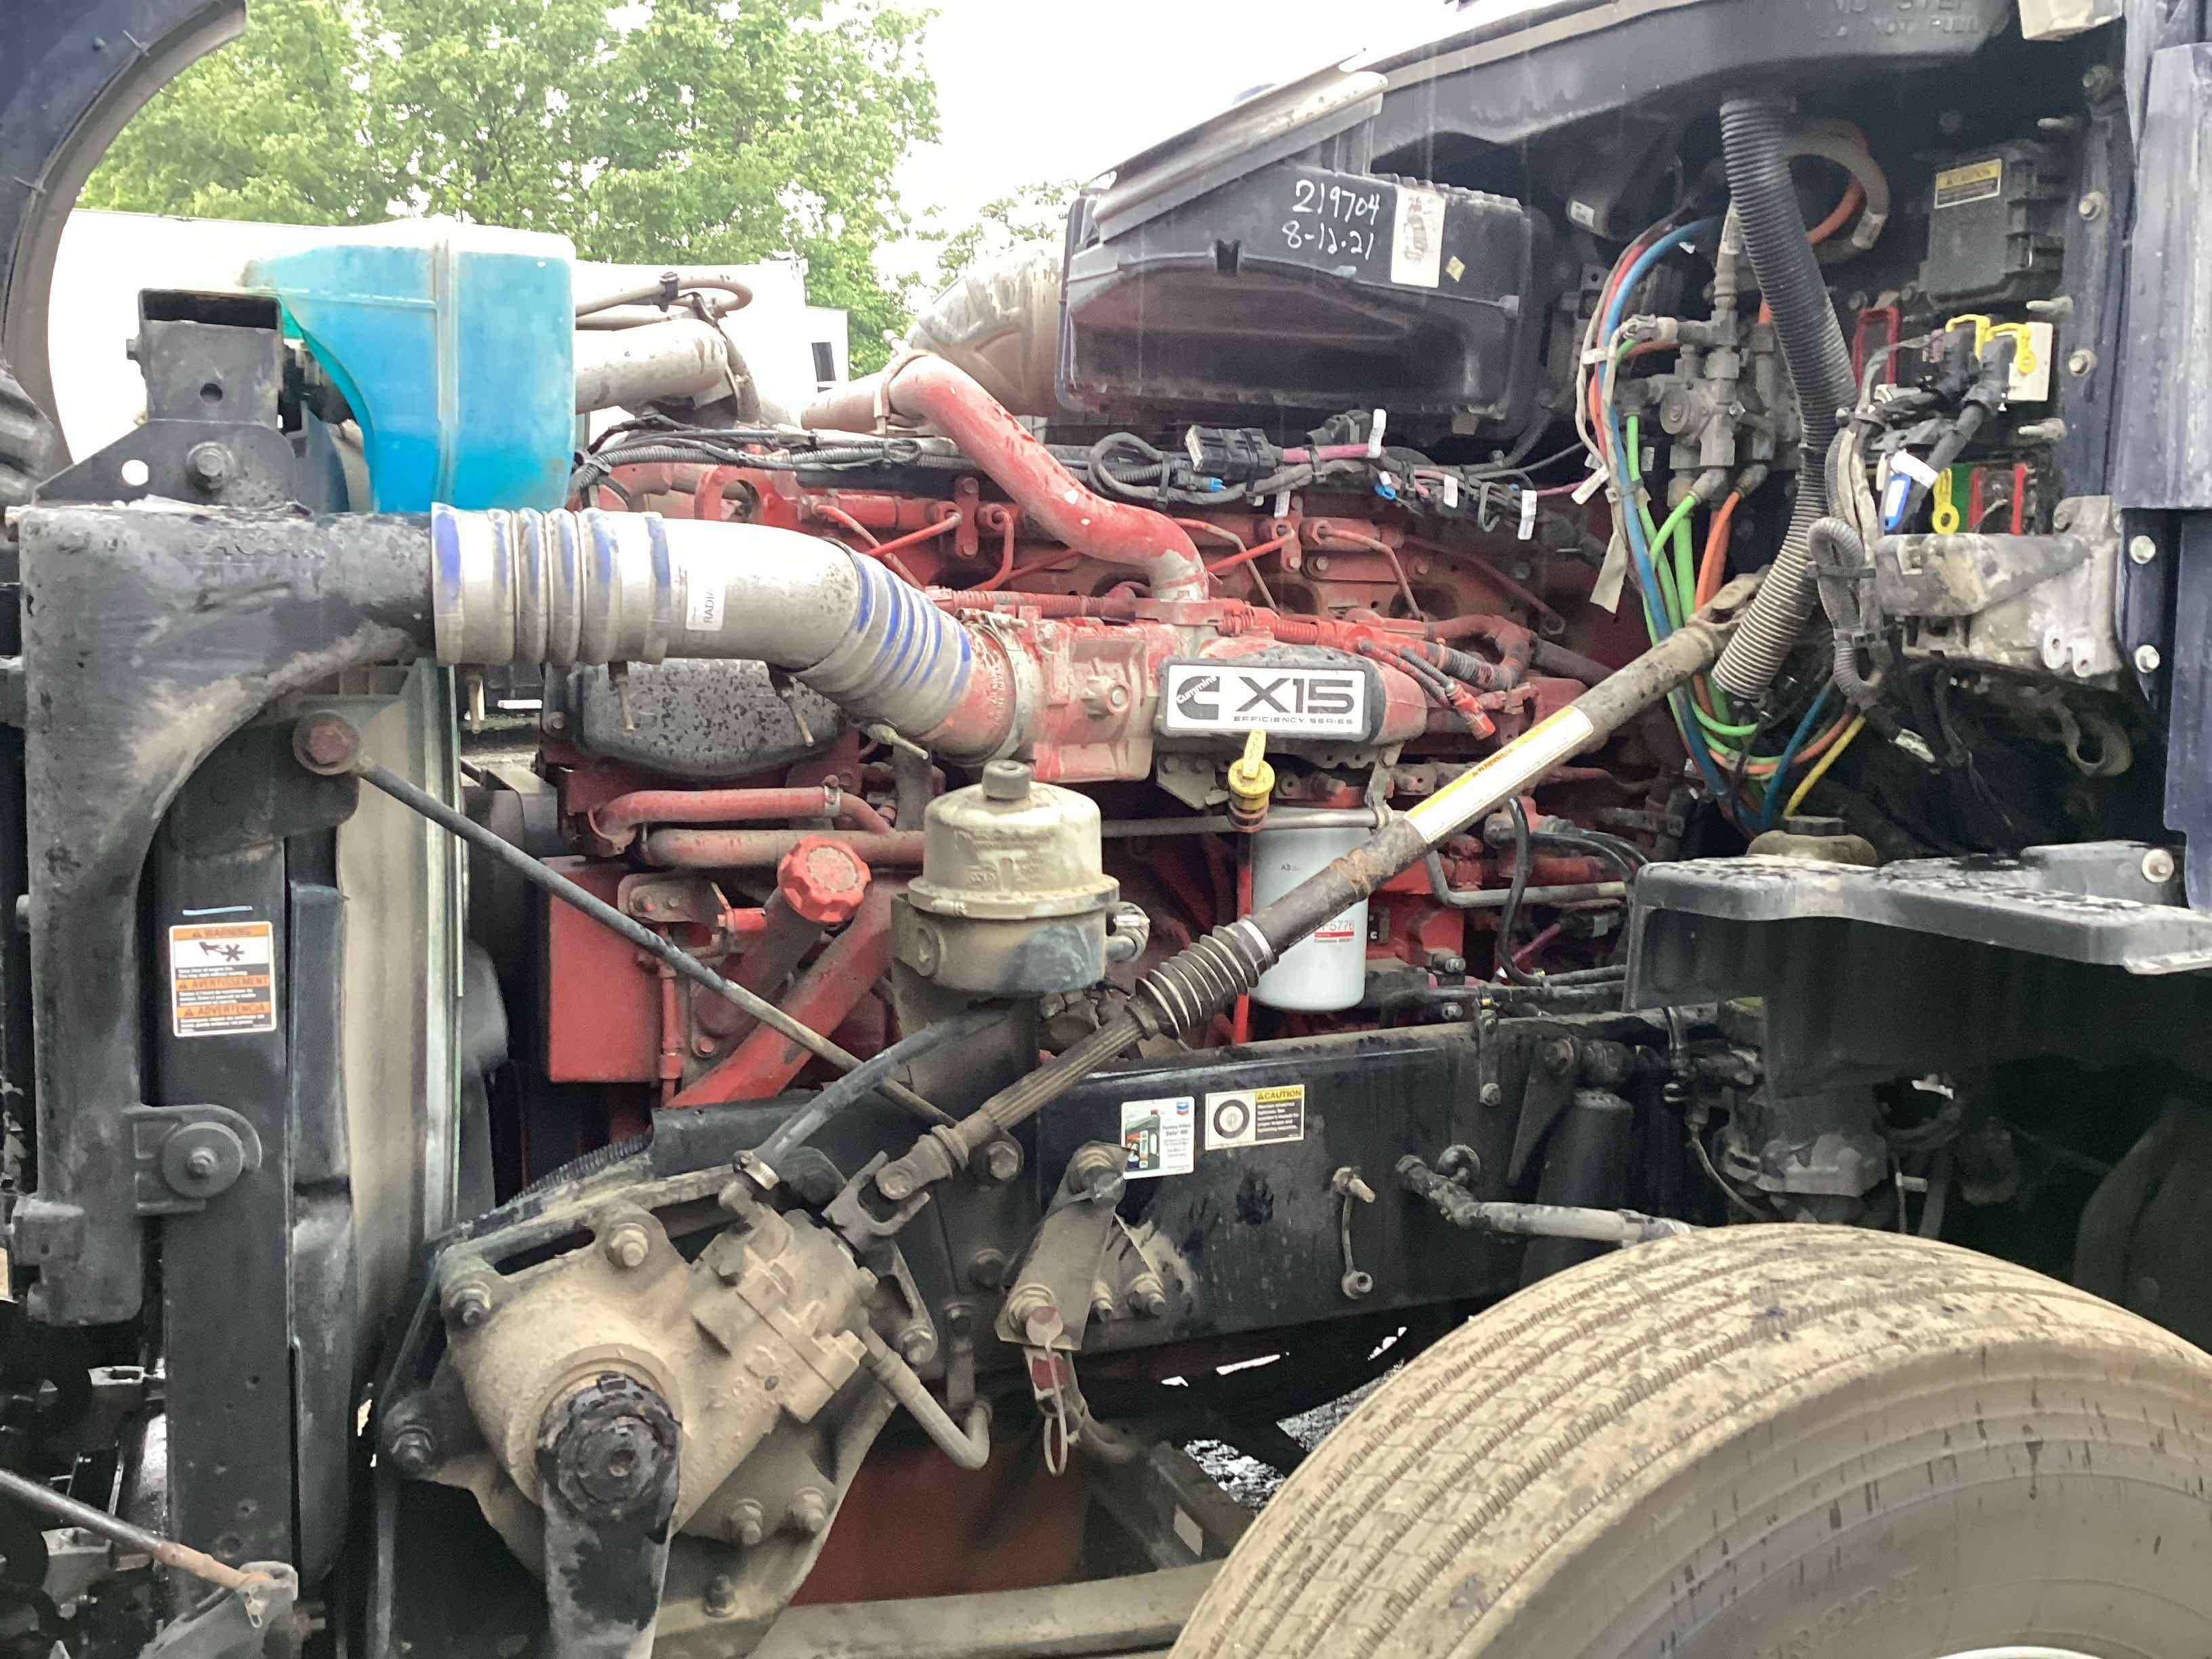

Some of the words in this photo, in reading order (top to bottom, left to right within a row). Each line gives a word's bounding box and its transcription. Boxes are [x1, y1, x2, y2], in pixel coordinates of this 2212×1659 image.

[1292, 179, 1380, 226] 219704
[1235, 676, 1355, 714] X15
[1233, 715, 1305, 724] EFFICIENCY
[1309, 717, 1354, 725] SERIES
[1264, 1089, 1302, 1100] CAUTION
